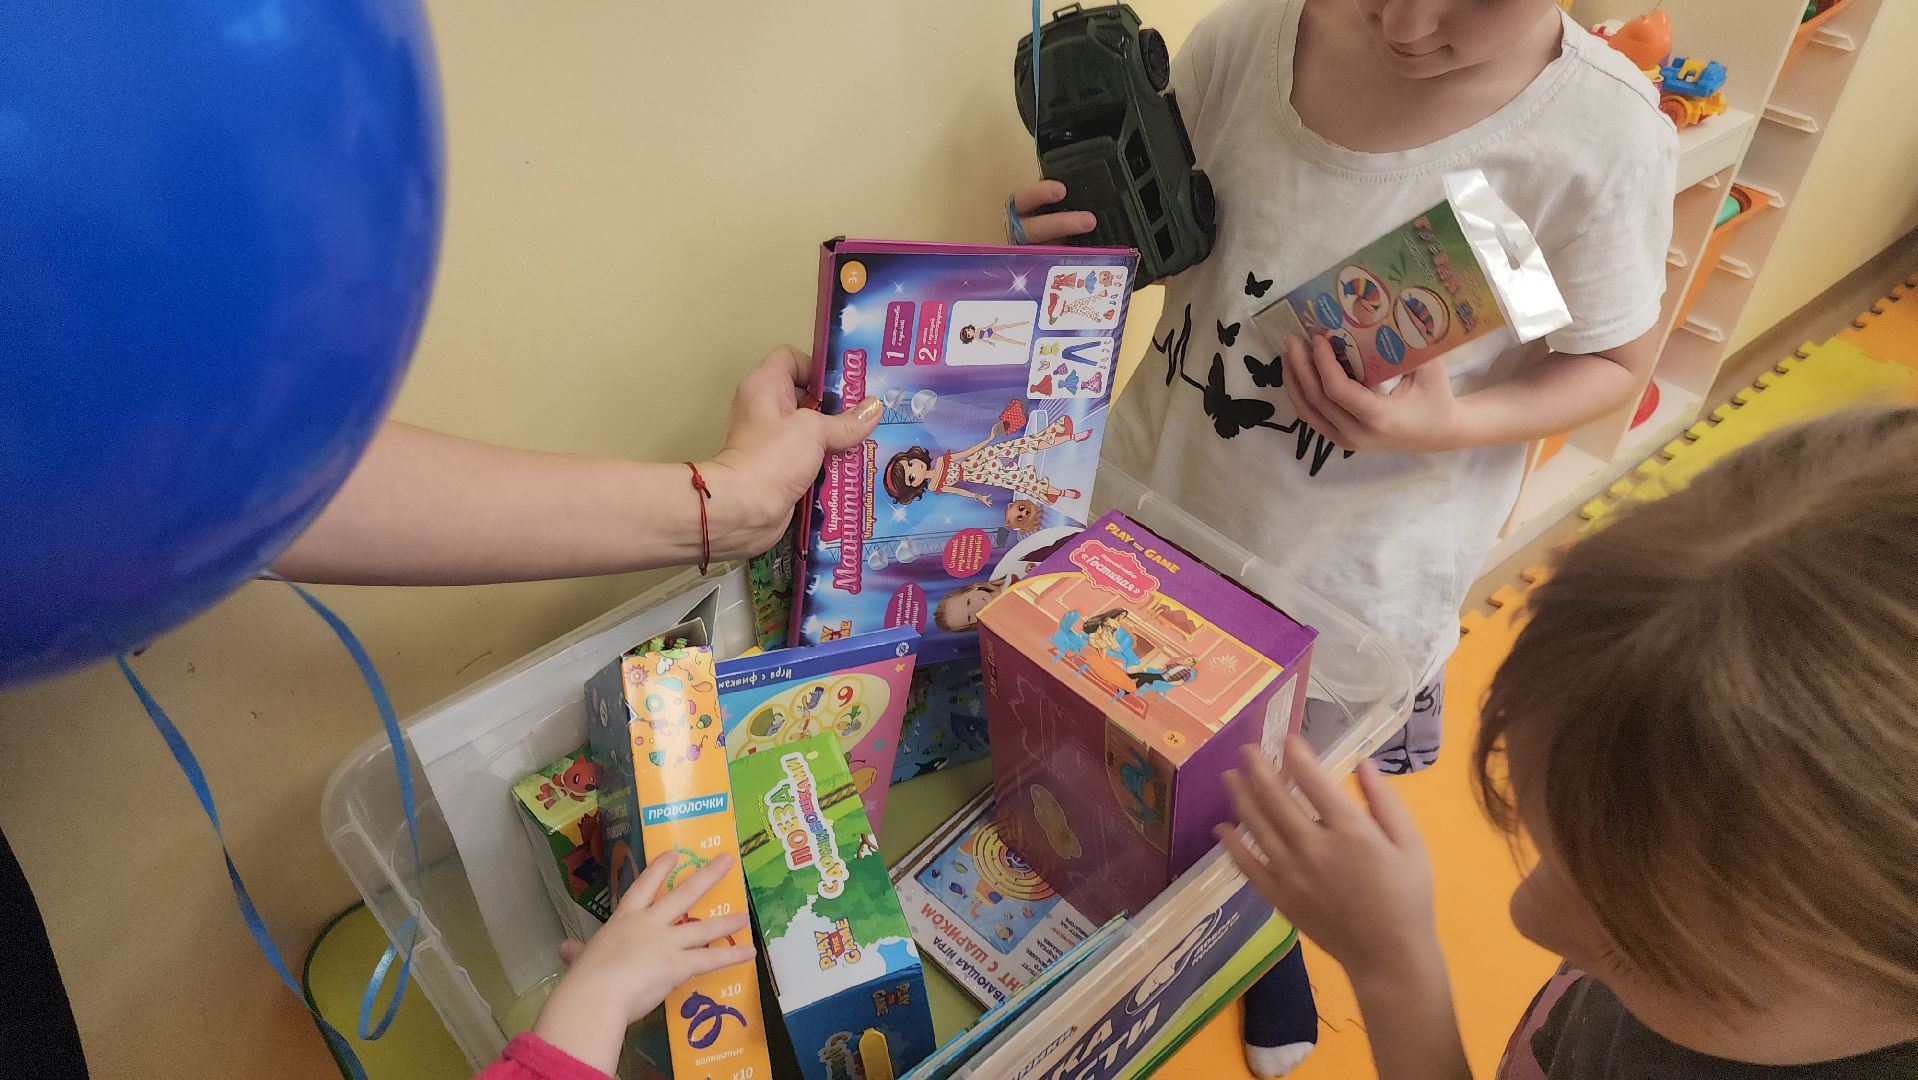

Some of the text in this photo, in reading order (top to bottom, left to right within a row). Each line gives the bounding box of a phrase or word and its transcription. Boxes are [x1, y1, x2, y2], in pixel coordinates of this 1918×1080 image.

[847, 269, 858, 284] 3+
[918, 346, 938, 362] 2
[835, 352, 863, 592] Магнитная кла
[865, 463, 877, 490] показы
[828, 454, 843, 534] Игровой набор
[863, 492, 877, 540] Устраивай
[1105, 522, 1135, 543] PLAY
[1144, 548, 1180, 575] GAME
[718, 670, 757, 689] фишкам
[769, 666, 792, 681] Игра
[648, 796, 724, 821] ПРОВОЛОЧКИ
[770, 783, 812, 866] ПОЕЗД
[785, 757, 843, 878] ДОМИНОШКАМИ
[814, 931, 837, 971] PLAY
[835, 918, 862, 965] GAME
[921, 903, 989, 965] ШАРИКОМ
[932, 936, 958, 961] ИГРА
